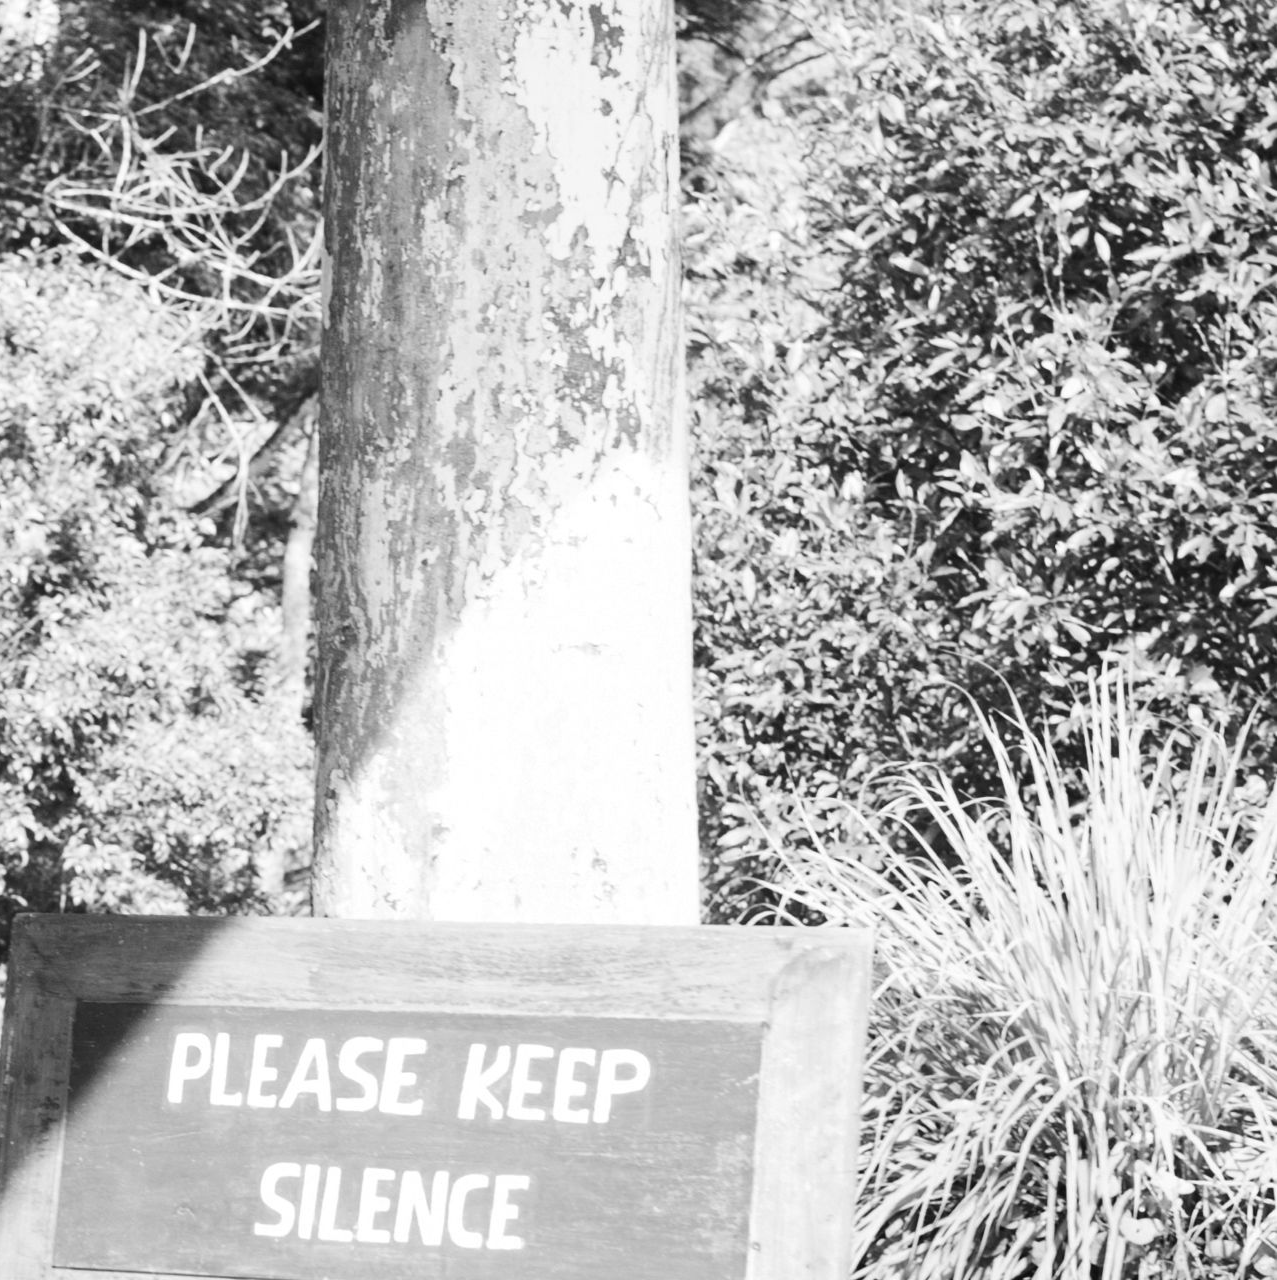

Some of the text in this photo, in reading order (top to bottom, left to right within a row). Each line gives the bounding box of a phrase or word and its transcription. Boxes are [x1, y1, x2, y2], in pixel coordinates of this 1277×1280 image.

[167, 1032, 651, 1124] PLEASE KEEP
[254, 1162, 530, 1251] SILENCE
